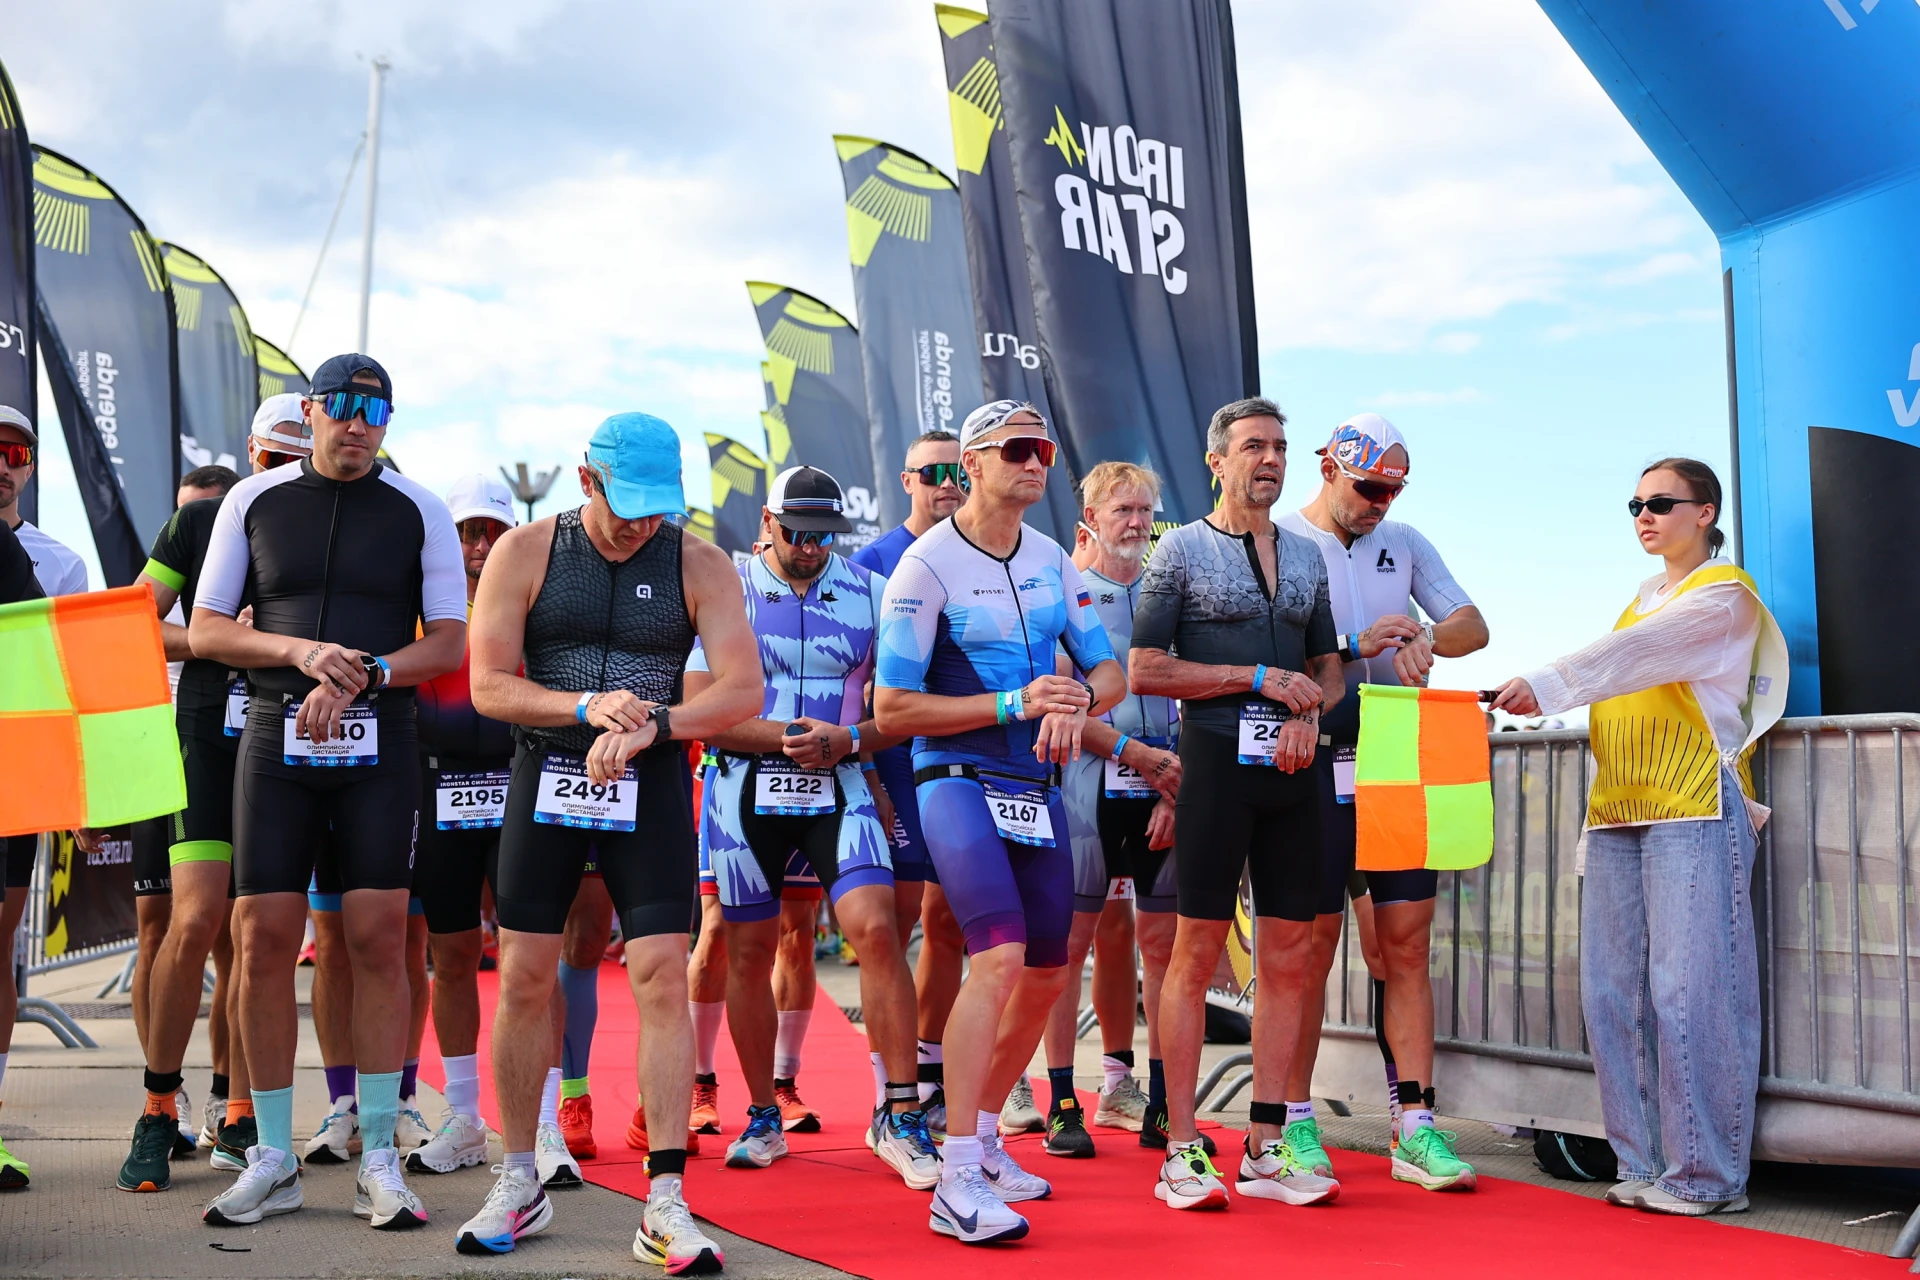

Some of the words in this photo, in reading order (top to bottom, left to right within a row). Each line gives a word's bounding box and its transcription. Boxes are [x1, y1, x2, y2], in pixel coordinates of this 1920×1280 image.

[891, 598, 923, 607] VLADIMIR
[894, 606, 917, 614] PISTIN
[304, 644, 325, 668] 2440
[1021, 687, 1031, 704] 167
[296, 722, 365, 740] 240
[1253, 724, 1281, 741] 24
[820, 736, 832, 760] 2122
[546, 765, 582, 774] IRONSTAR
[1117, 763, 1142, 777] 21
[554, 778, 621, 803] 2491
[769, 777, 822, 794] 2122
[451, 789, 504, 807] 2195
[561, 802, 610, 812] ОЛИМПИЙСКАЯ
[565, 808, 605, 817] ДИСТАНЦИЯ
[997, 802, 1038, 823] 2167
